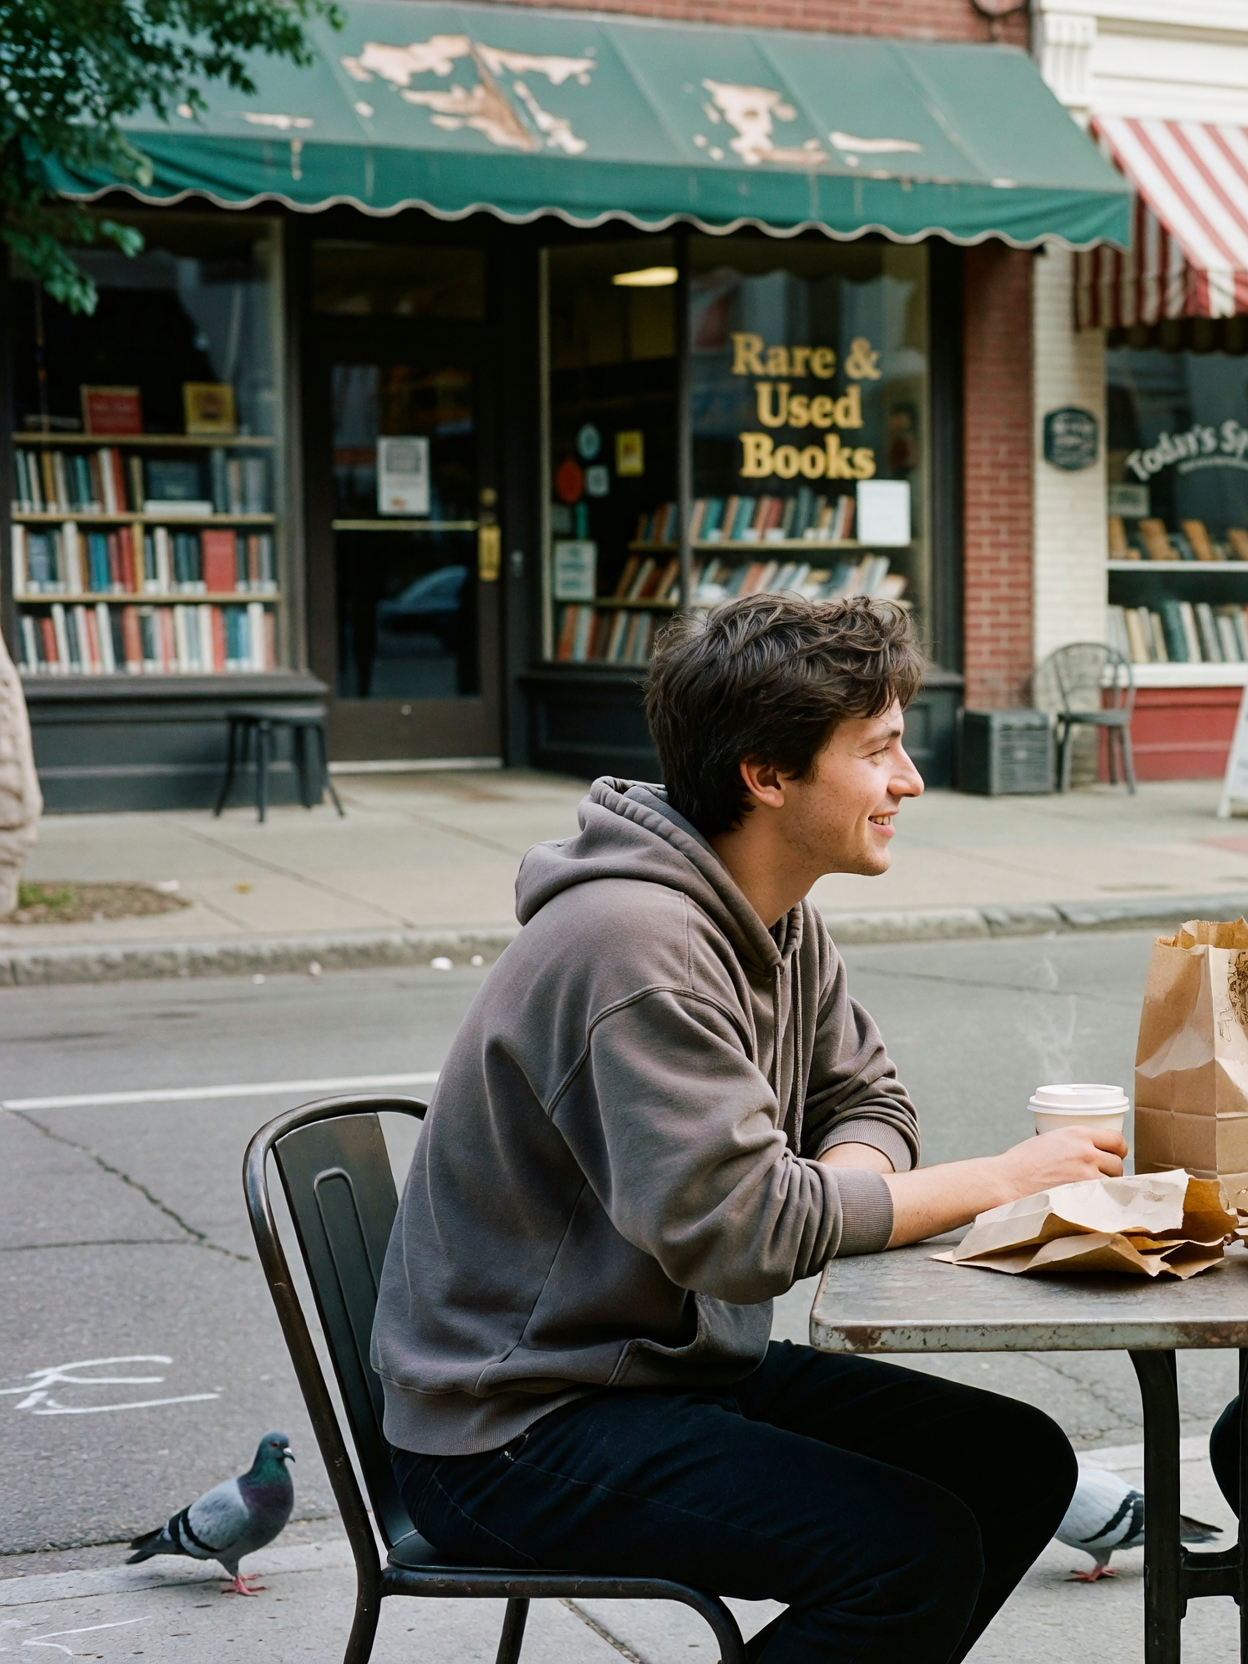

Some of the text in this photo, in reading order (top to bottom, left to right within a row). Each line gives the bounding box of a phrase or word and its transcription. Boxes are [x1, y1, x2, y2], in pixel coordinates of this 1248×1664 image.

[731, 331, 882, 380] Rare &
[755, 381, 864, 429] Used
[739, 431, 877, 480] Books
